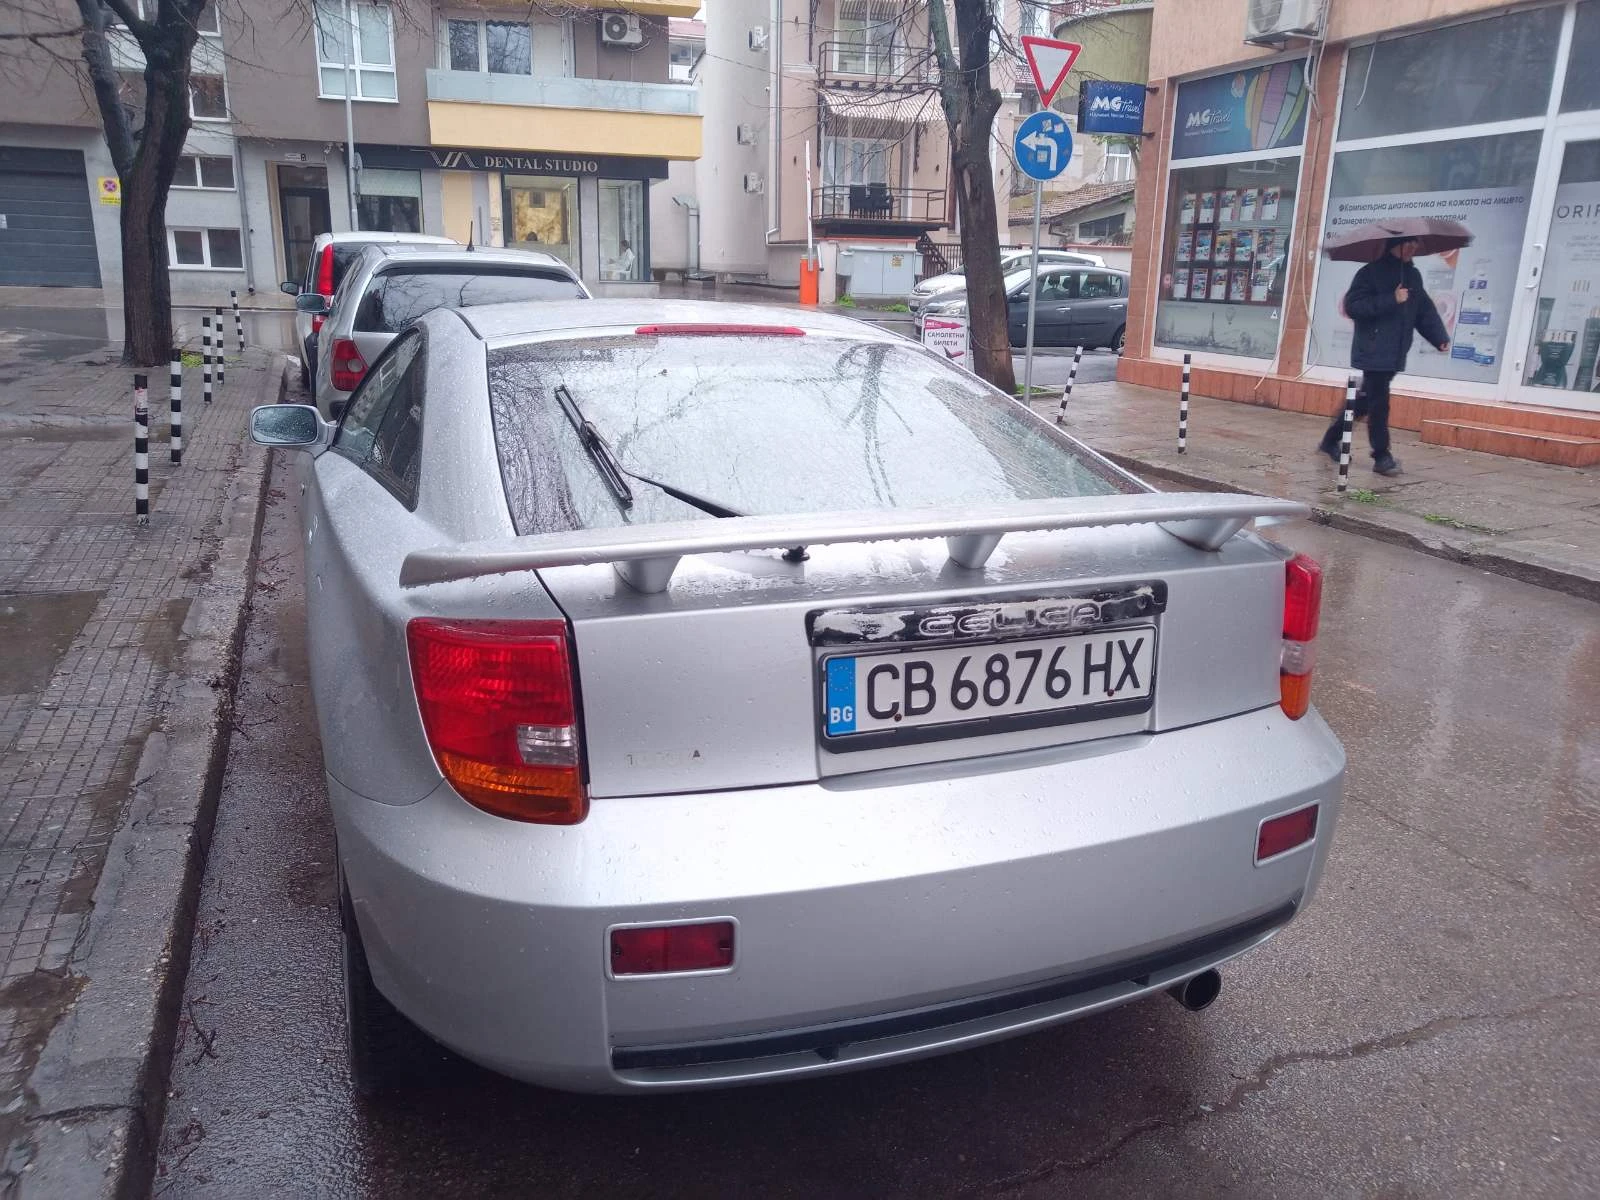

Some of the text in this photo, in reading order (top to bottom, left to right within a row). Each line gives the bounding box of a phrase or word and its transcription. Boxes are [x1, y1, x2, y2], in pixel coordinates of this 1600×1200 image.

[1090, 95, 1121, 111] MG
[1185, 108, 1211, 128] MG
[484, 156, 542, 170] DENTAL
[544, 158, 598, 172] STUDIO
[1388, 200, 1435, 210] диагностика
[1436, 199, 1447, 207] на
[1448, 199, 1479, 208] кожата
[1480, 196, 1492, 206] на
[866, 637, 1145, 720] CB 6876 HX
[829, 705, 853, 725] BG
